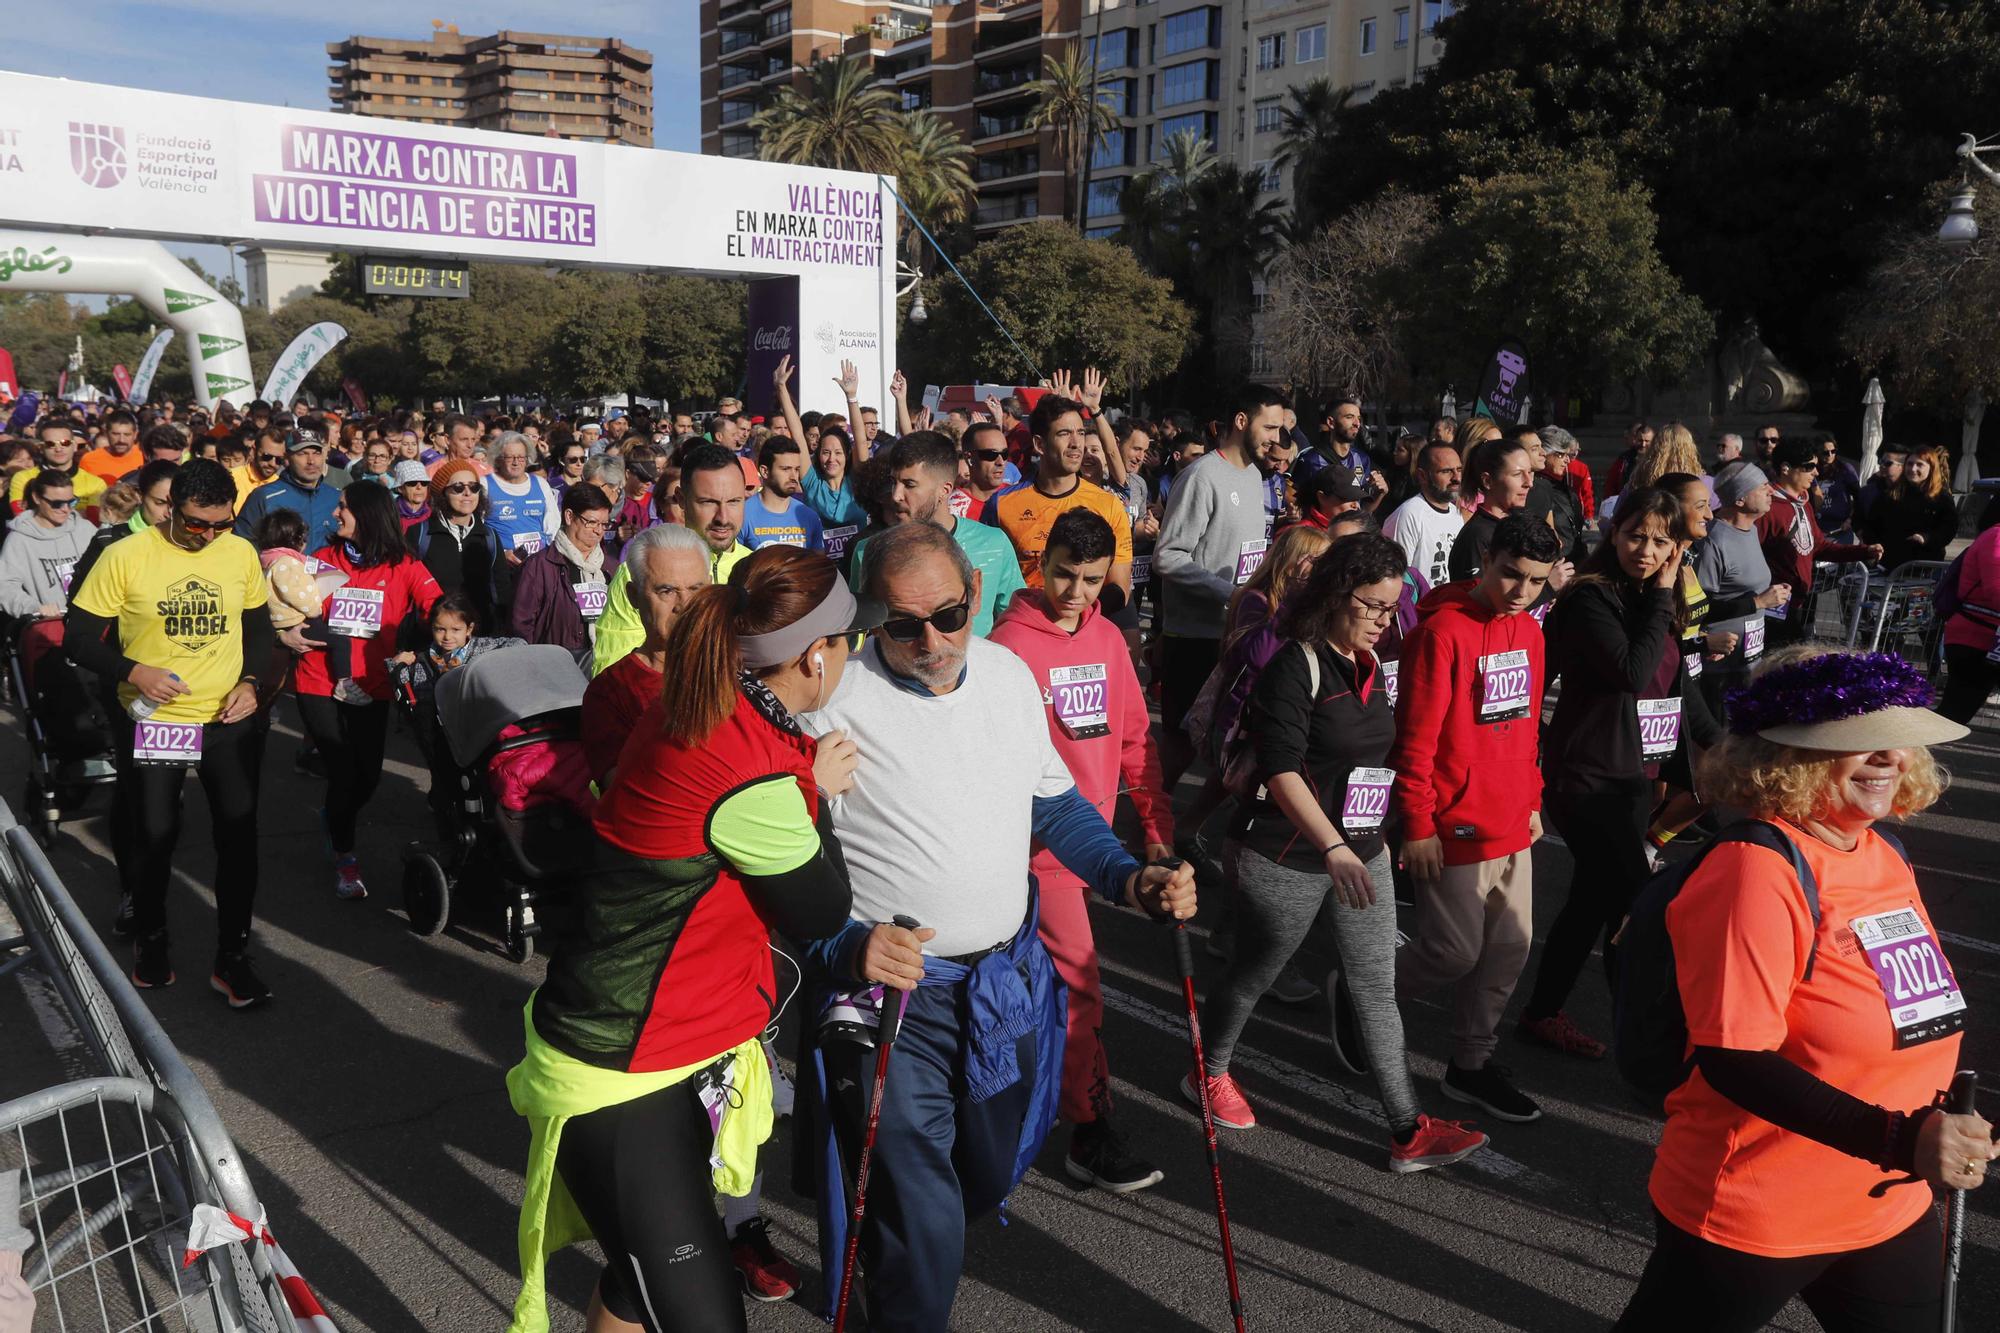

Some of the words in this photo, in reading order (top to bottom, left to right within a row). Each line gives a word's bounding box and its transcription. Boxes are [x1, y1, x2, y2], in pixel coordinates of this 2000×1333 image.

[135, 133, 212, 152] Fundació
[136, 147, 216, 167] Esportiva
[292, 130, 403, 179] MARXA
[411, 143, 527, 191] CONTRA
[536, 156, 570, 194] LA
[137, 162, 217, 181] Municipal
[138, 175, 208, 194] València
[262, 180, 430, 232] VIOLÈNCIA
[438, 196, 476, 235] DE
[485, 195, 594, 244] GÈNERE
[787, 182, 883, 220] VALÈNCIA
[736, 210, 757, 233] EN
[763, 212, 818, 239] MARXA
[823, 218, 883, 244] CONTRA
[727, 234, 746, 258] EL
[751, 236, 883, 268] MALTRACTAMENT
[372, 265, 463, 289] 0:00:14
[839, 339, 877, 349] ALANNA
[157, 600, 219, 616] SUBIDA
[335, 600, 377, 622] 2022
[1060, 683, 1103, 715] 2022
[1488, 669, 1527, 701] 2022
[142, 725, 197, 750] 2022
[1640, 715, 1677, 743] 2022
[1346, 787, 1386, 815] 2022
[1879, 941, 1951, 1001] 2022
